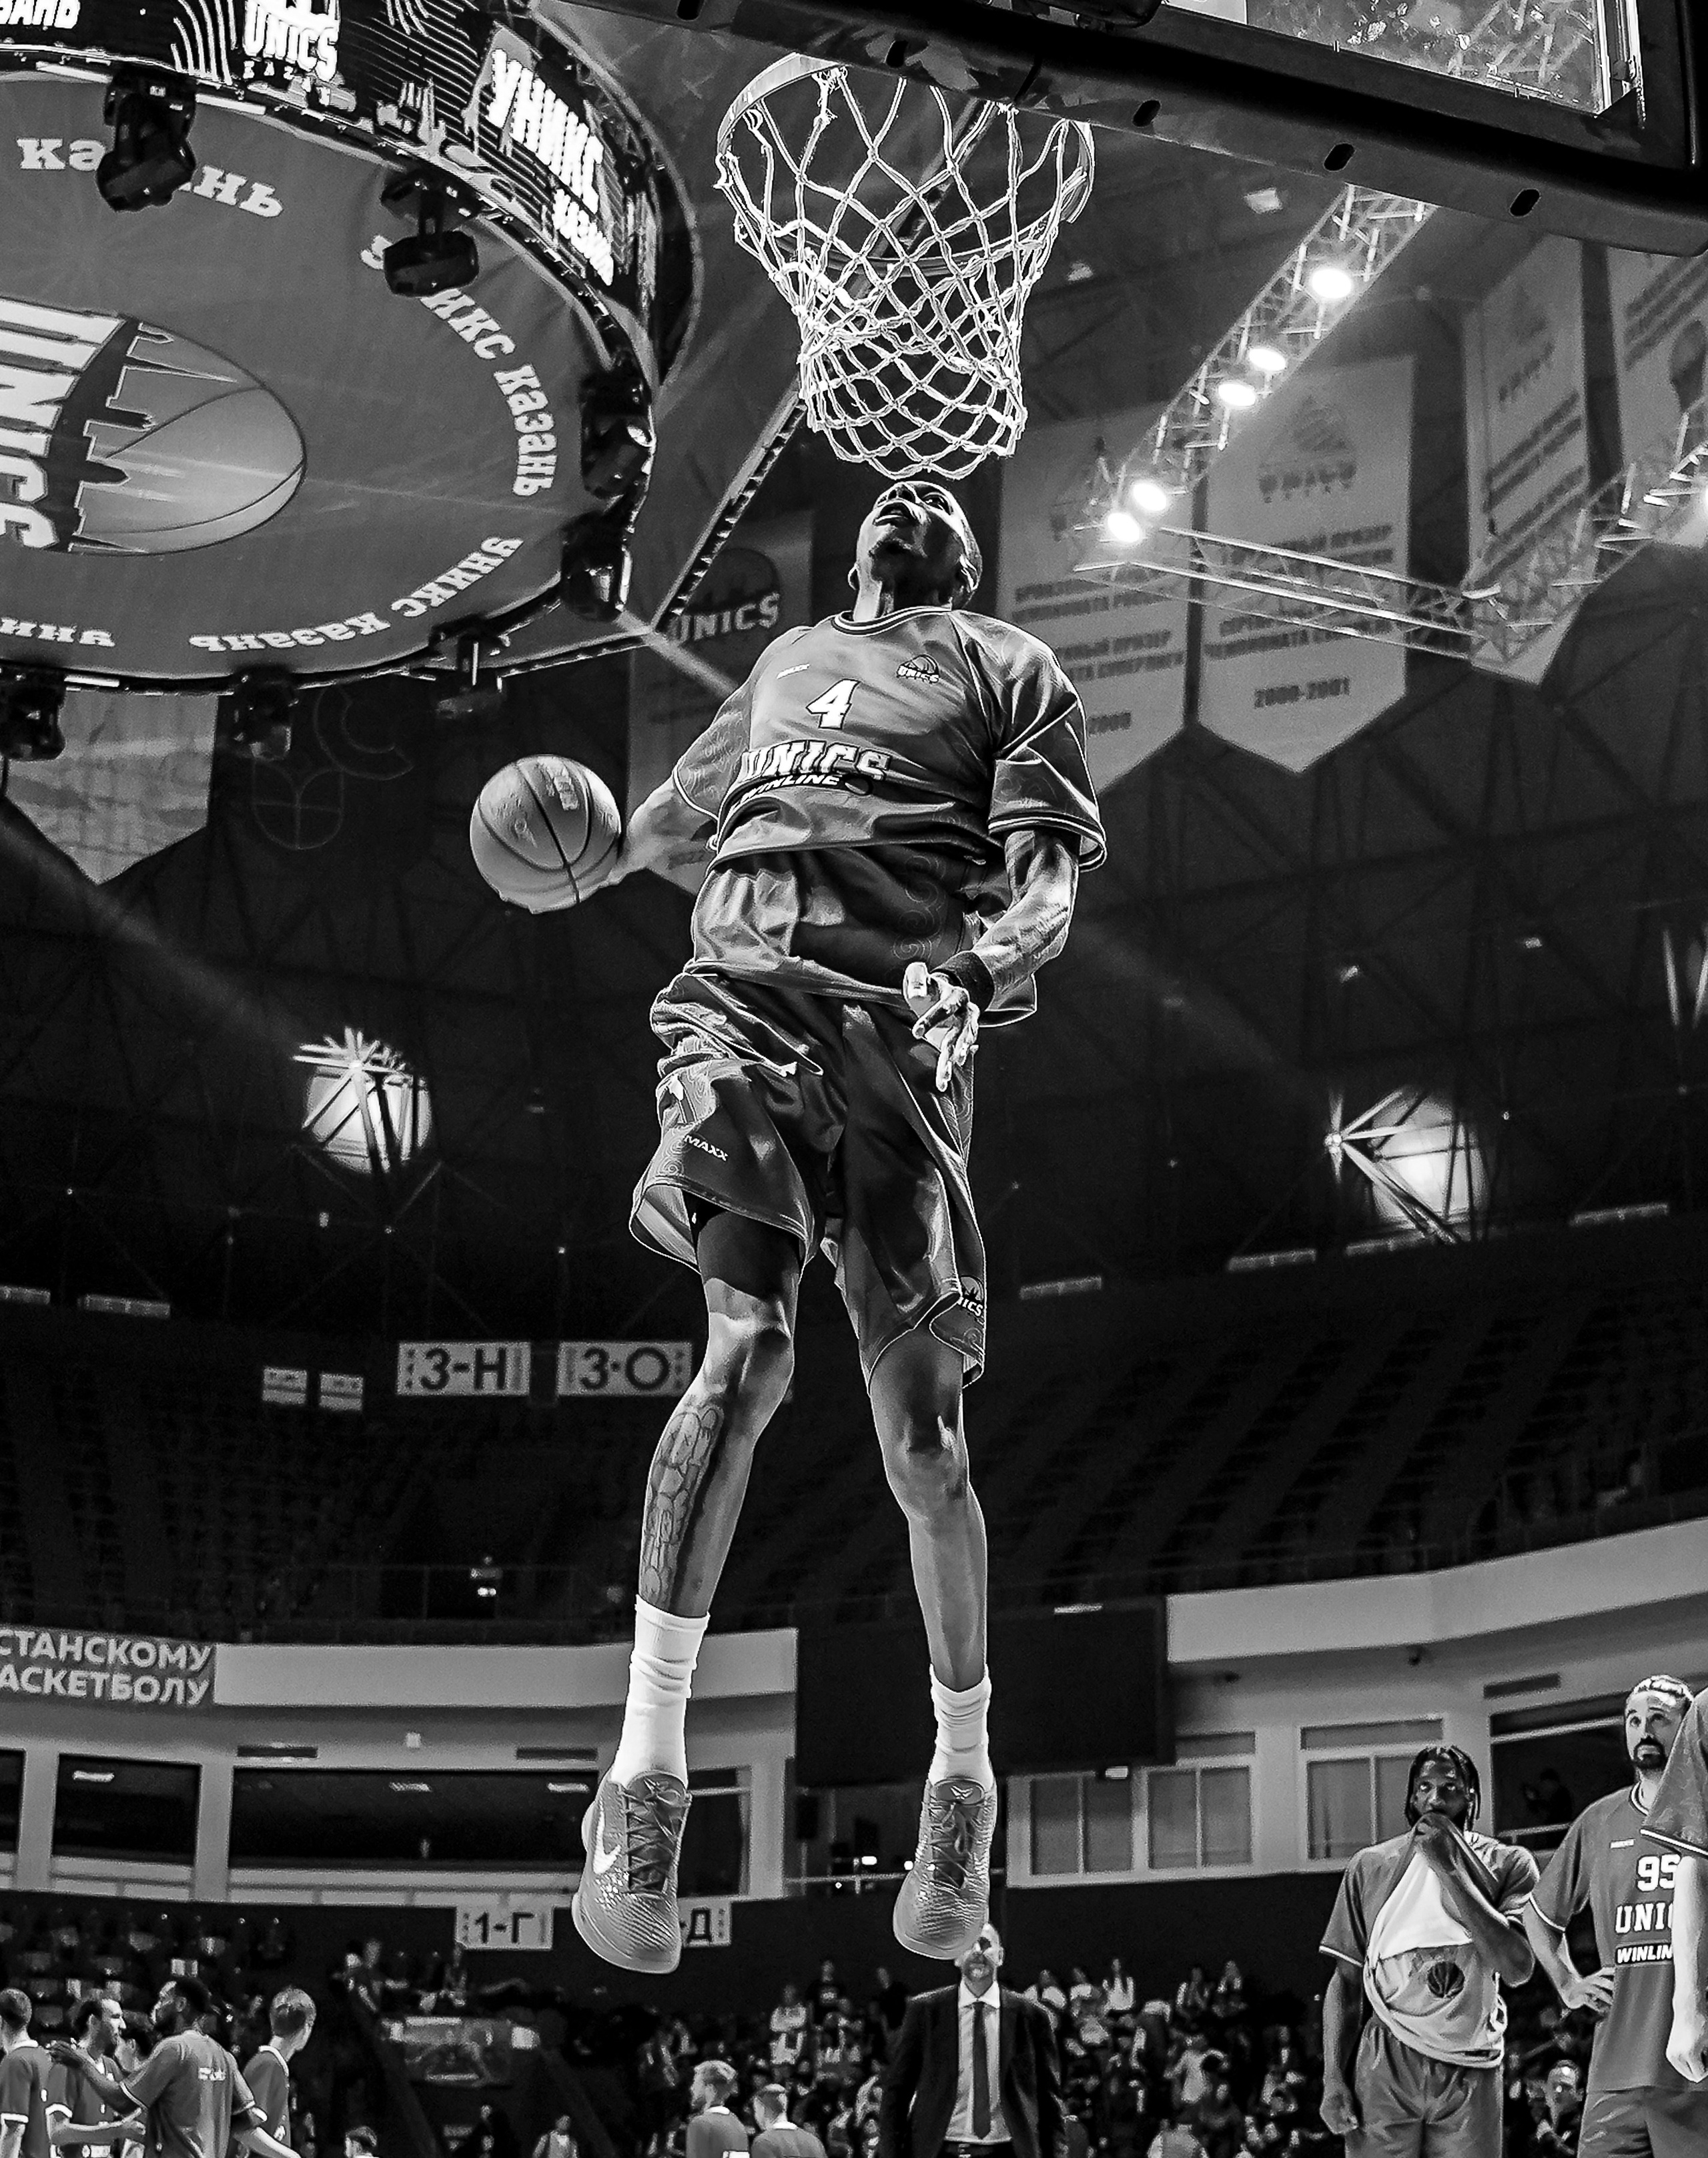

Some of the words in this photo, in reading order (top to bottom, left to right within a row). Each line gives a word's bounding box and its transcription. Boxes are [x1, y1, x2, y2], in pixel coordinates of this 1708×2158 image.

[243, 0, 340, 82] UNICS
[486, 48, 604, 215] УНИКС
[668, 592, 781, 642] UNICS
[897, 664, 941, 684] UNICS
[805, 678, 861, 730] 4
[741, 739, 892, 781] UNICS
[684, 1134, 729, 1161] MAXX
[956, 1296, 983, 1317] ICS
[0, 1664, 210, 1705] АСКЕТБОЛУ
[1637, 1854, 1681, 1892] 95
[1615, 1903, 1673, 1934] UNI
[1617, 1944, 1673, 1964] WINLIN
